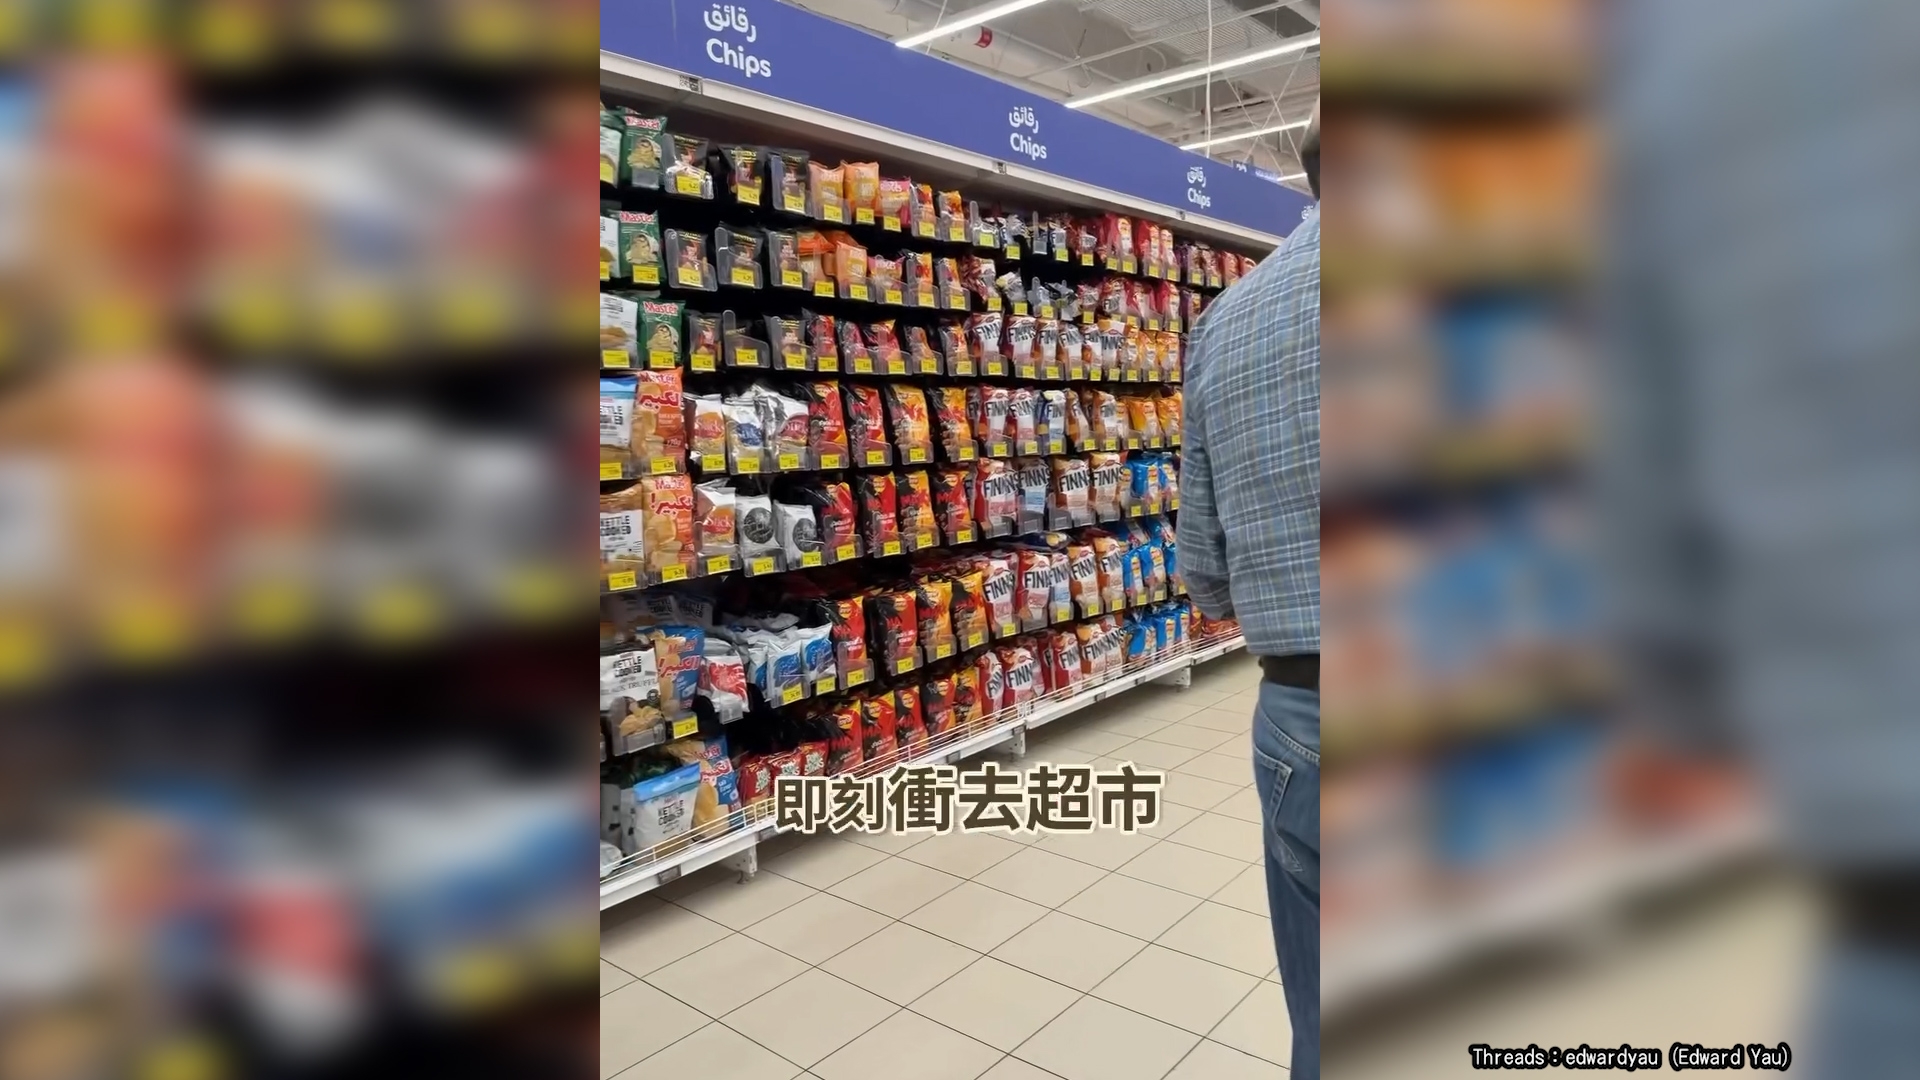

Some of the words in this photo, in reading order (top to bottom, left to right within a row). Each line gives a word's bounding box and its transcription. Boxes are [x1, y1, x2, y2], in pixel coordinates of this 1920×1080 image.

[703, 3, 757, 43] رقائق
[706, 38, 772, 78] Chips
[1008, 105, 1040, 134] رقائق
[1009, 132, 1048, 161] Chips
[1187, 187, 1212, 210] Chips
[643, 301, 679, 316] Master
